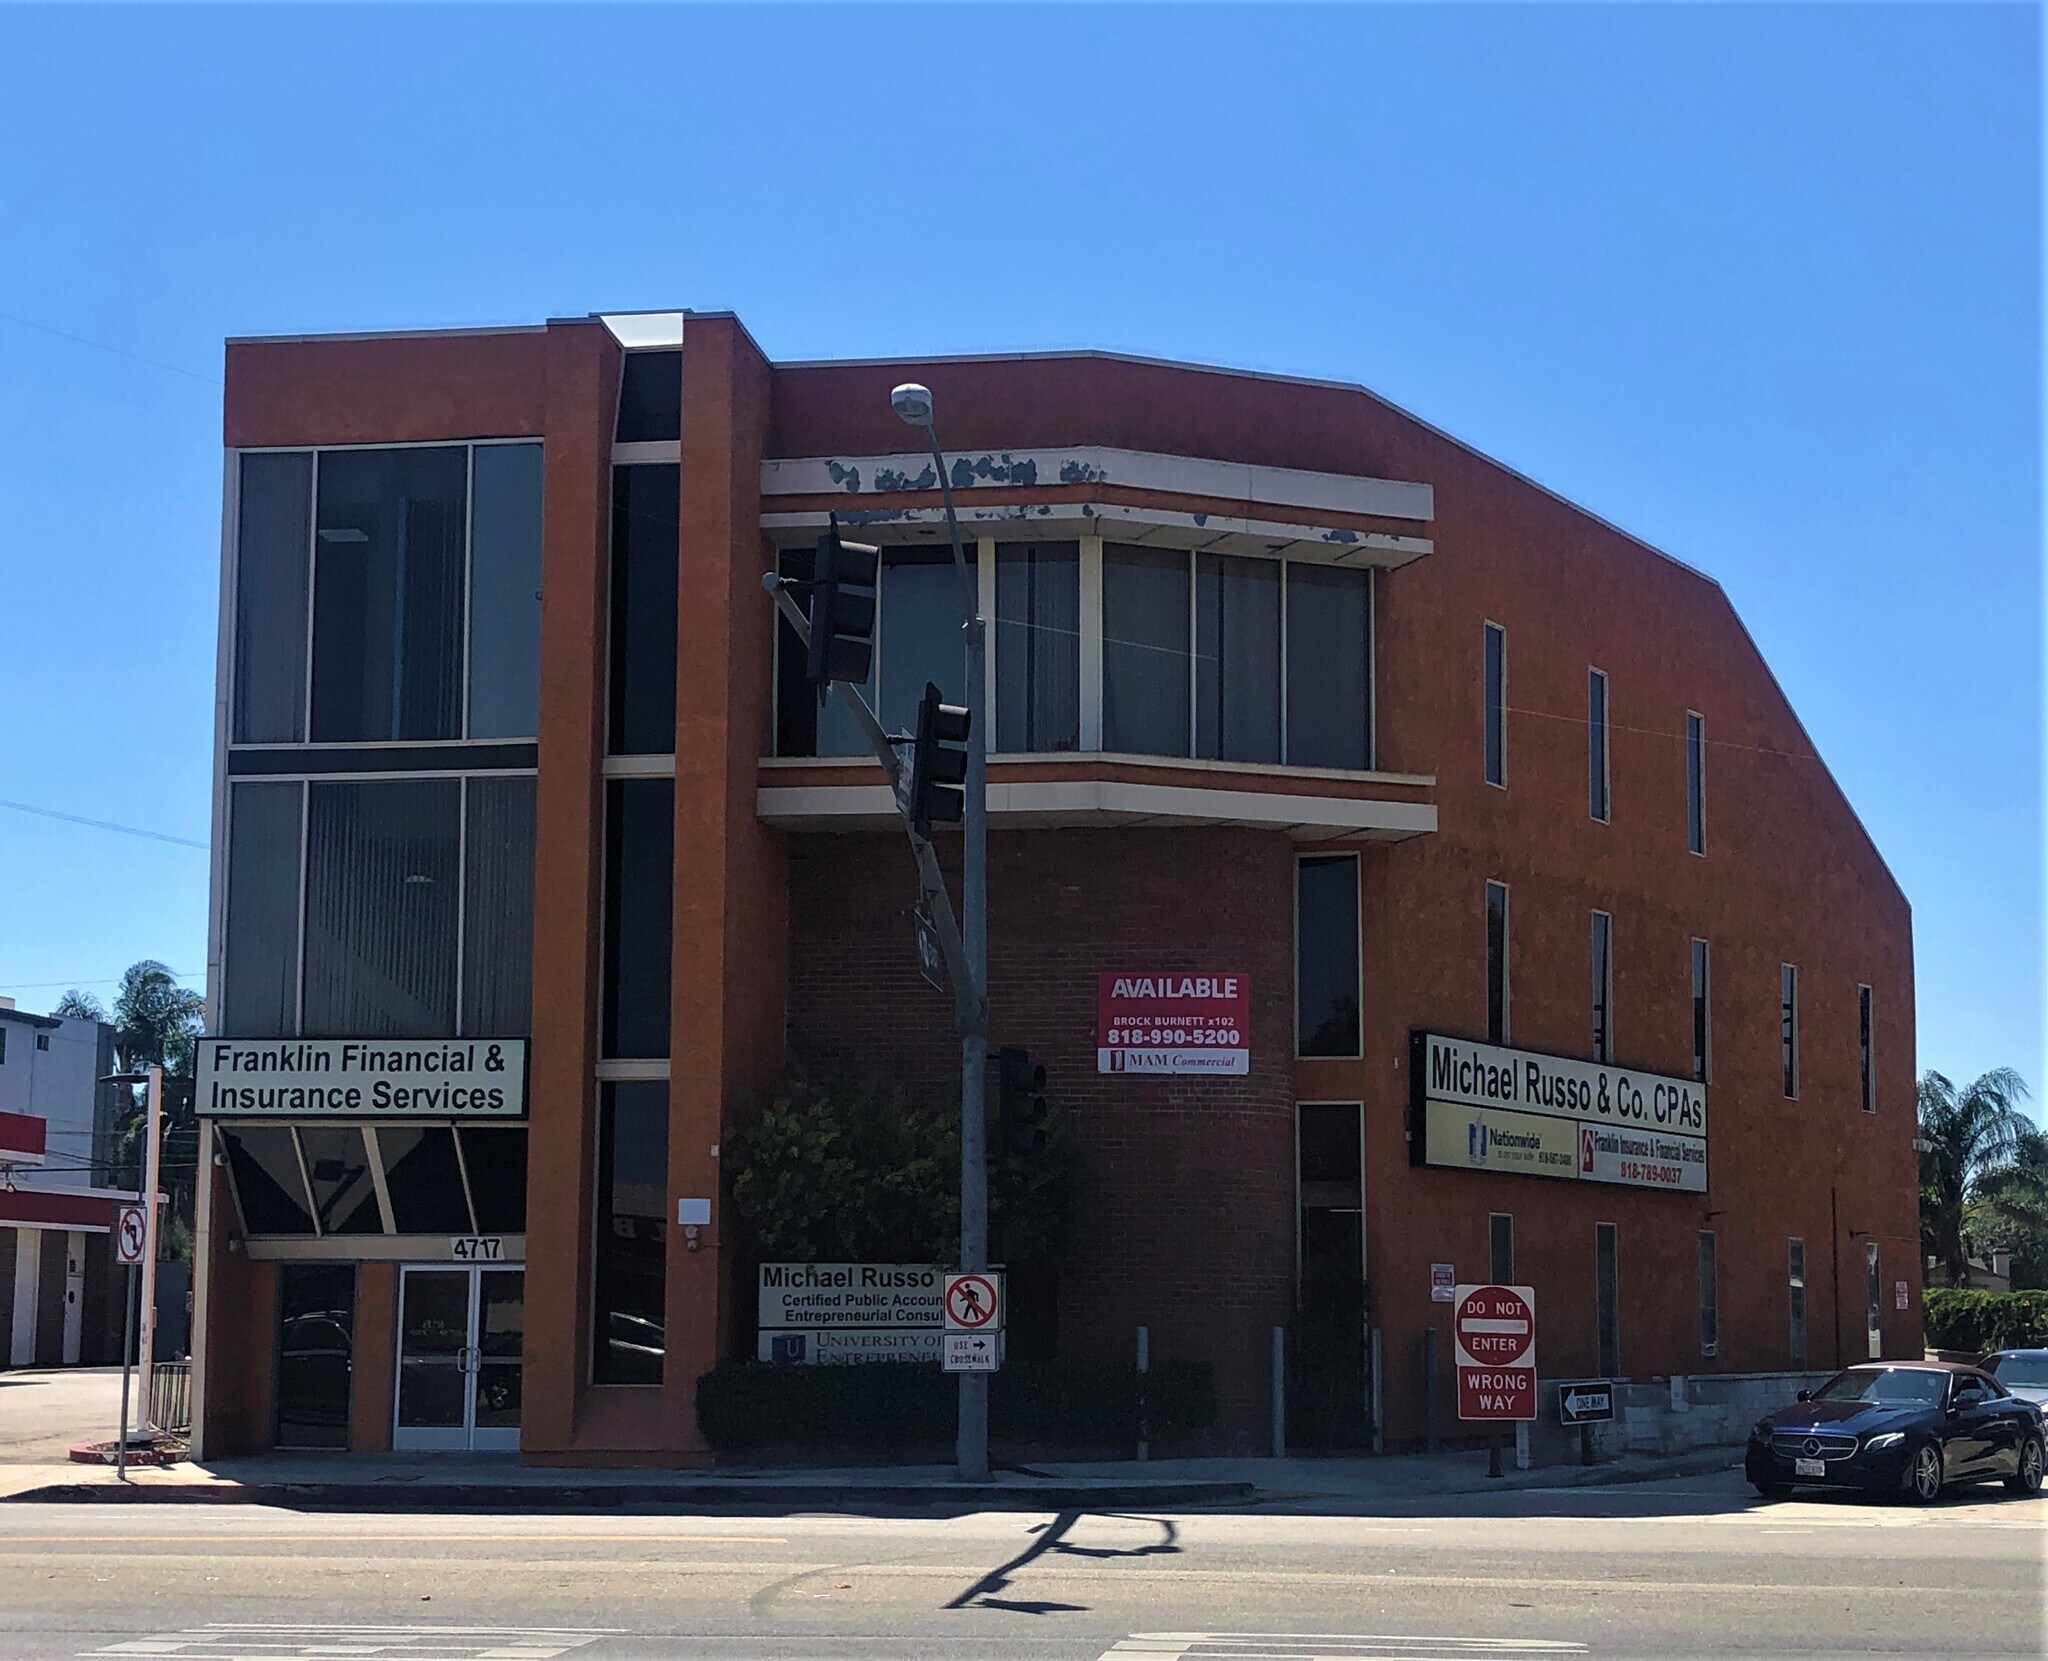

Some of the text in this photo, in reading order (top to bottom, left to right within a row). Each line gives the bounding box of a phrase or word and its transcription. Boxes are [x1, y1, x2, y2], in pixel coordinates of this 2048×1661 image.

[1111, 978, 1238, 998] AVAILABLE
[1113, 1017, 1235, 1026] BROCK BURNETT x102
[1107, 1029, 1240, 1045] 818-990-5200
[213, 1044, 506, 1072] Franklin Financial &
[1130, 1053, 1236, 1067] MAM Commercial
[1432, 1044, 1702, 1129] Michael Russo & Co. CPAs
[211, 1080, 504, 1109] Insurance Services
[1490, 1128, 1540, 1149] Nationwide
[1621, 1161, 1682, 1183] 818-789-0037
[454, 1239, 500, 1258] 4717
[763, 1267, 935, 1288] Michael Russo
[782, 1294, 943, 1307] Certified Public Accoun
[1467, 1302, 1522, 1315] DO NOT
[785, 1309, 943, 1324] Entrepreneurial Consul
[816, 1332, 920, 1347] UNIVERSITY
[953, 1340, 968, 1349] USE
[1472, 1338, 1517, 1351] ENTER
[950, 1353, 990, 1365] CROSSWALK
[1467, 1374, 1527, 1390] WRONG
[1479, 1395, 1516, 1410] WAY
[1577, 1395, 1605, 1409] ONE WAY
